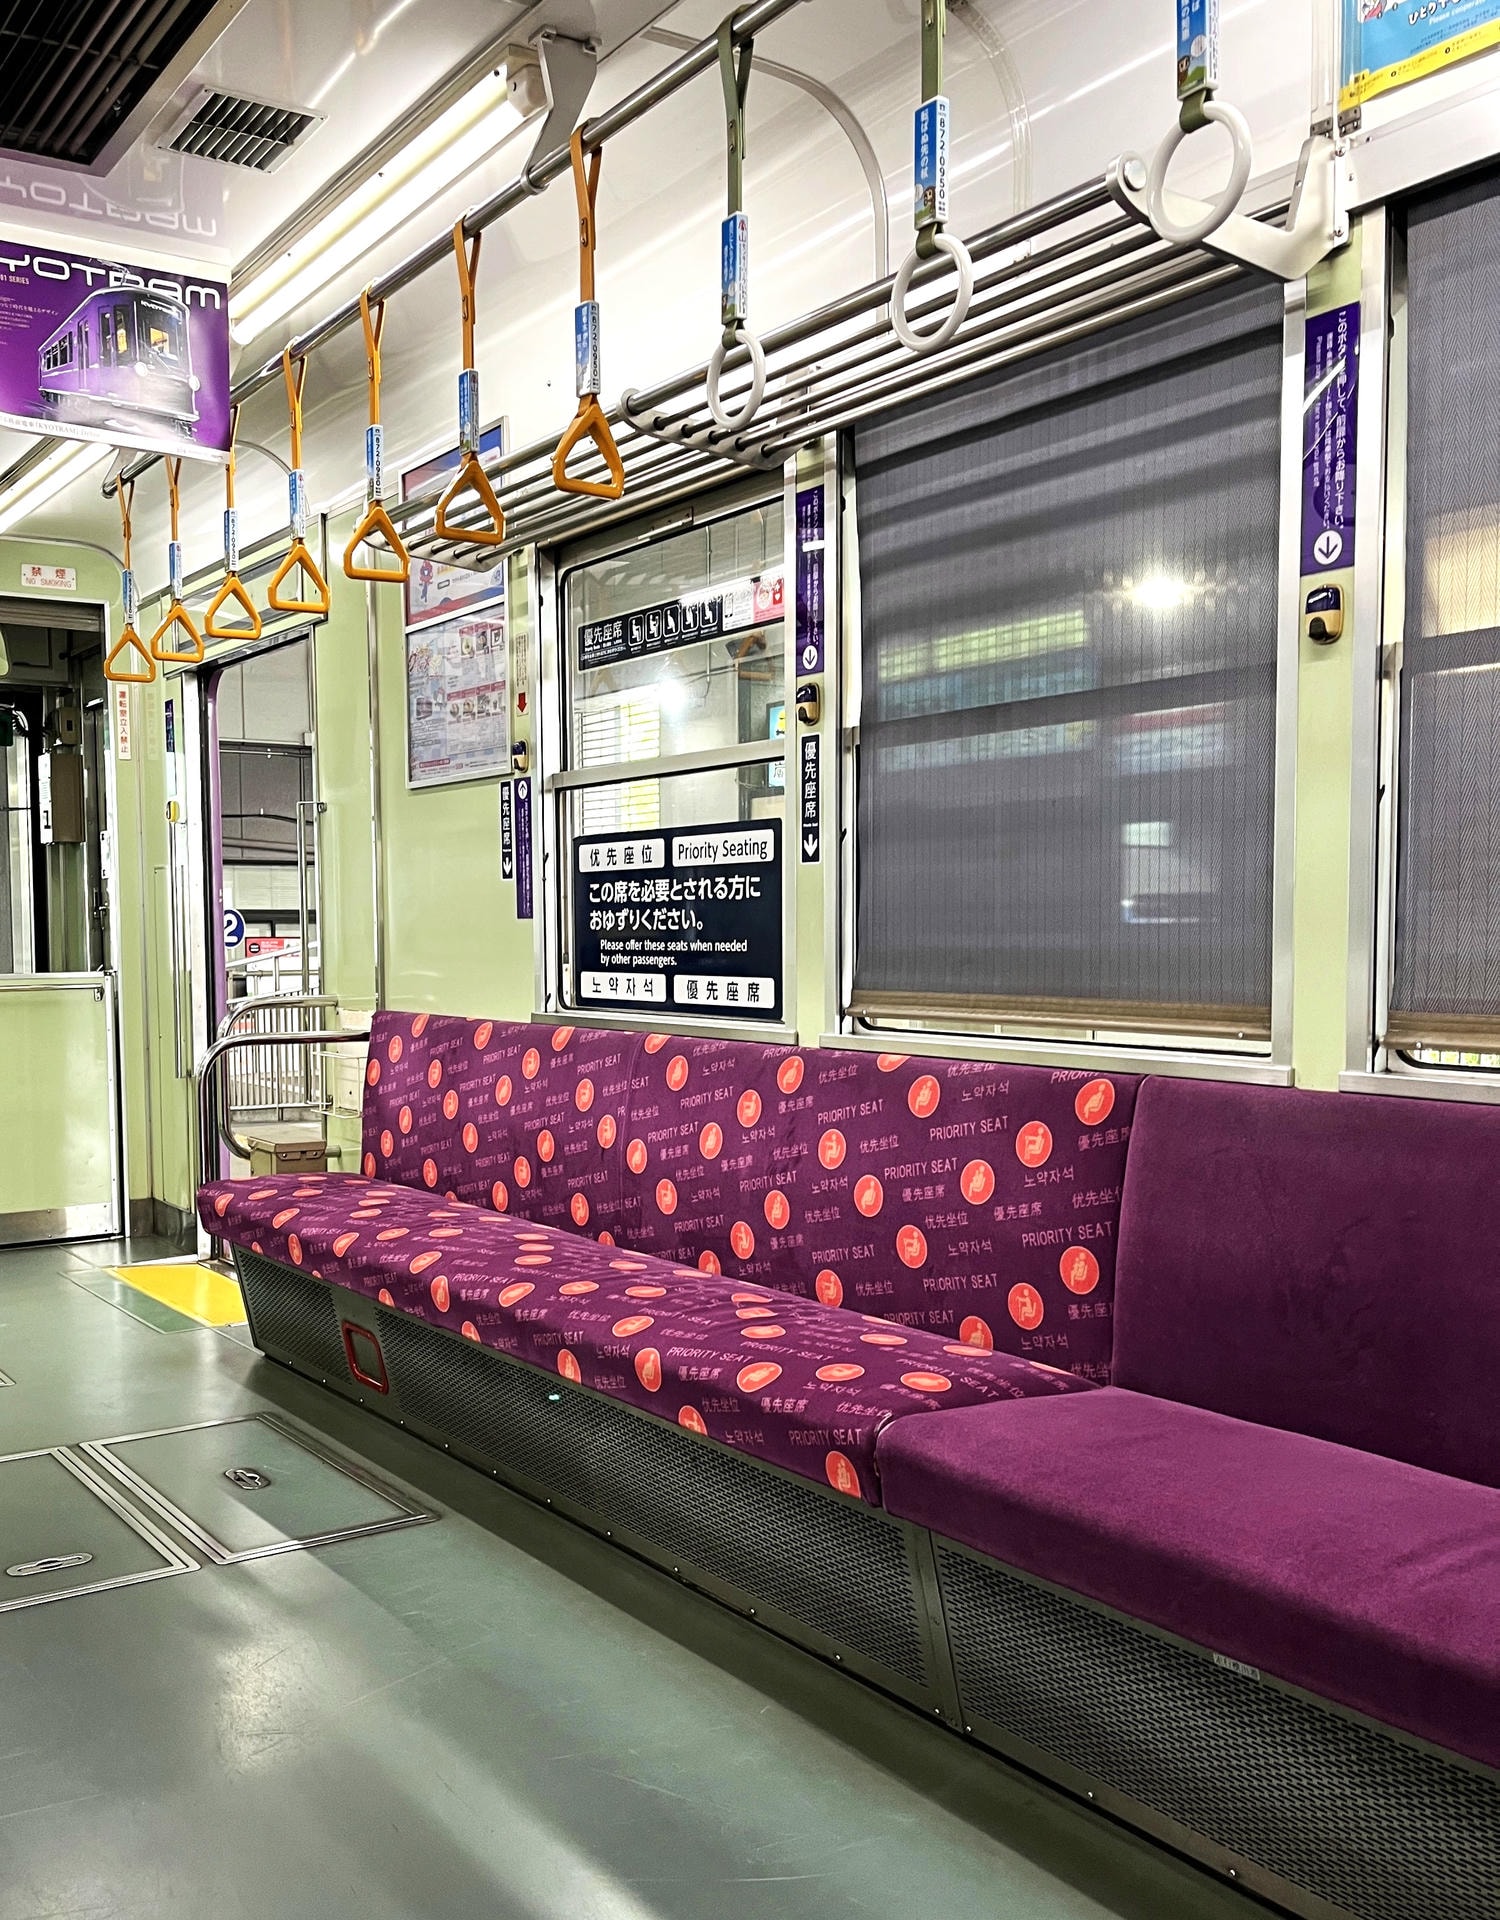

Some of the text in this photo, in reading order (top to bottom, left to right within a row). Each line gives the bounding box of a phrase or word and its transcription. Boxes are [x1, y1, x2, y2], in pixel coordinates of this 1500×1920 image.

[31, 566, 66, 579] 禁煙
[26, 577, 72, 588] NO SMOKING
[584, 621, 622, 646] 優先座席
[118, 690, 128, 754] 運転室立入禁止
[805, 741, 817, 819] 優先座席
[589, 845, 653, 867] 优先座位
[678, 838, 768, 863] Priority Seating
[588, 875, 761, 904] この席を必要とされる方に
[223, 912, 239, 943] 2
[589, 909, 704, 932] おゆずりください。
[600, 939, 748, 953] Please offer these seats when needed
[600, 953, 678, 969] by other passengers.
[592, 977, 654, 996] 노약자석
[686, 980, 760, 1003] 優先座席
[483, 1045, 520, 1064] PRIORITY SEAT
[577, 1054, 621, 1075] PRIORITY SEAT
[460, 1073, 496, 1092] PRIORITY SEAT
[631, 1076, 649, 1088] SEAT
[818, 1065, 857, 1084] 优先坐位
[681, 1087, 733, 1109] PRIORITY SEAT
[962, 1081, 1009, 1102] 노약자석
[778, 1096, 814, 1114] 優先座席
[818, 1100, 883, 1124] PRIORITY SEAT
[524, 1112, 564, 1130] PRIORITY SEAT
[930, 1116, 1008, 1141] PRIORITY SEAT
[648, 1122, 698, 1143] PRIORITY SEAT
[742, 1127, 775, 1145] 노약자석
[772, 1144, 808, 1161] 优先坐位
[860, 1135, 899, 1153] 优先坐位
[884, 1158, 958, 1179] PRIORITY SEAT
[1024, 1166, 1074, 1188] 노약자석
[568, 1170, 608, 1188] PRIORITY SEAT
[740, 1171, 797, 1192] PRIORITY SEAT
[811, 1177, 848, 1194] 노약자석
[903, 1185, 945, 1201] 優先座席
[625, 1197, 641, 1209] SEAT
[994, 1201, 1042, 1221] 優先座席
[674, 1216, 724, 1233] PRIORITY SEAT
[925, 1211, 968, 1229] 优先坐位
[1022, 1222, 1112, 1247] PRIORITY SEAT
[678, 1247, 695, 1259] SEAT
[812, 1245, 875, 1263] PRIORITY SEAT
[948, 1240, 992, 1257] 노약자석
[923, 1273, 997, 1292] PRIORITY SEAT
[533, 1331, 583, 1346] PRIORITY SEAT
[667, 1347, 754, 1362] PRIORITY SEAT
[897, 1359, 998, 1398] PRIORITY SEAT
[761, 1398, 809, 1413] 優先座席
[789, 1428, 862, 1446] PRIORITY SEAT
